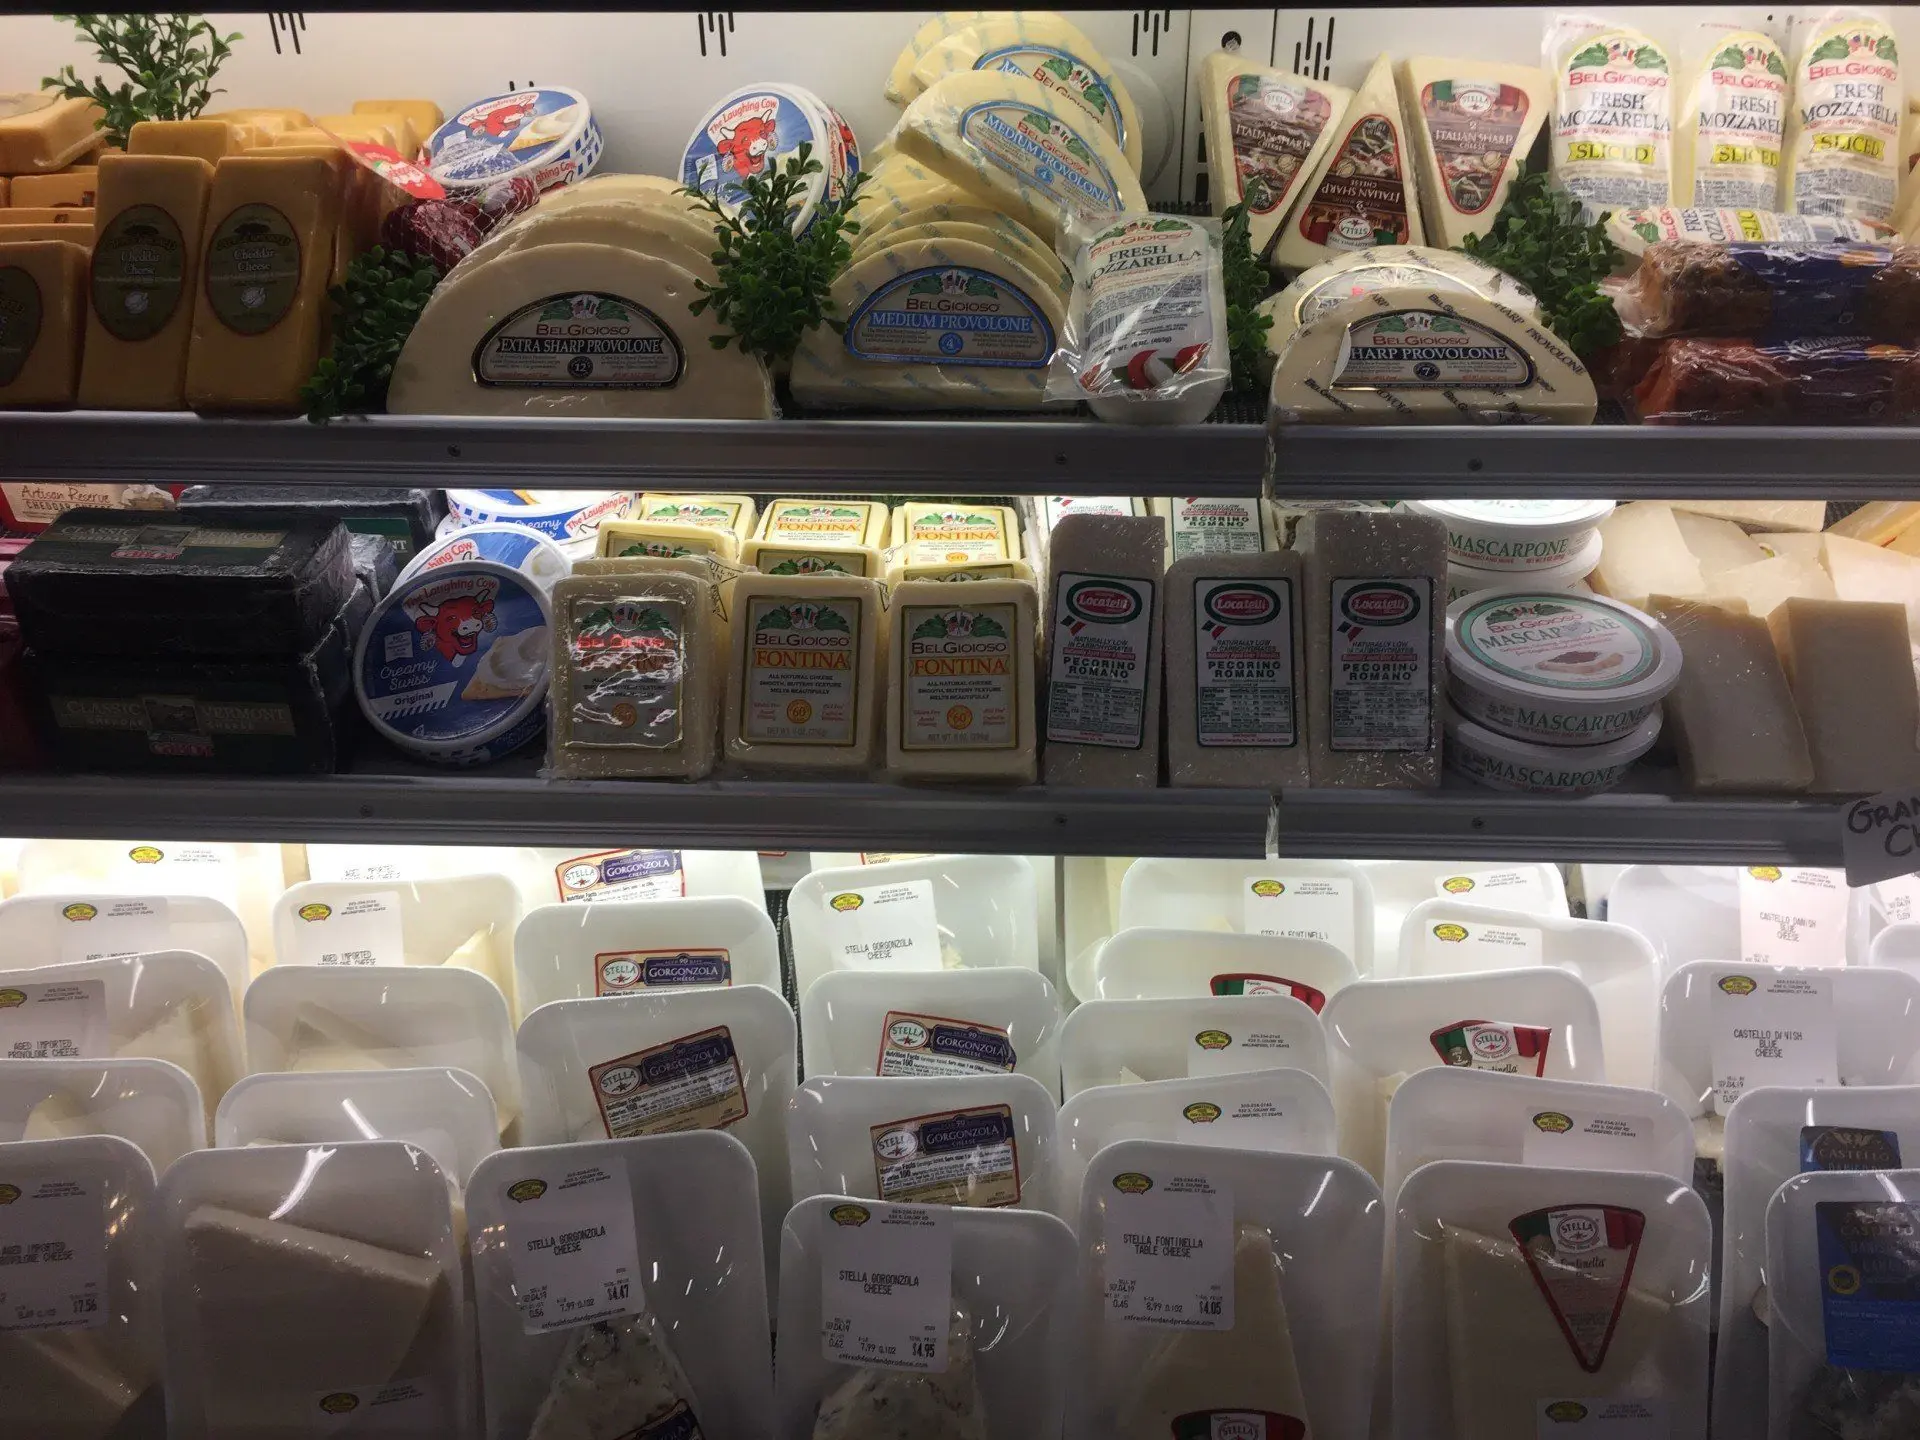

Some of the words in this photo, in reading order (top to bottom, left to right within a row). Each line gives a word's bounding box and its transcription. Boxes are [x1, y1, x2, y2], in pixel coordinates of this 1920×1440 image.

[1835, 84, 1884, 100] FRESH
[1592, 92, 1647, 109] FRESH
[1731, 95, 1778, 115] FRESH
[709, 121, 724, 135] The
[722, 101, 761, 123] Laughing
[760, 98, 778, 110] Cow
[1559, 110, 1670, 131] MOZZARELLA
[1801, 102, 1897, 127] MOZZARELLA
[1237, 124, 1274, 141] ITALIAN
[1274, 136, 1311, 149] SHARP
[1436, 130, 1478, 141] ITALIAN
[1480, 134, 1515, 144] SHARP
[1821, 135, 1881, 156] SLICED
[985, 112, 1040, 157] MEDIUM
[1038, 151, 1110, 207] PROVOLONE
[1322, 183, 1357, 196] SHARP
[1360, 189, 1401, 203] ITALIAN
[233, 248, 274, 261] Cheddar
[1110, 246, 1169, 264] FRESH
[237, 261, 271, 271] Cheese
[872, 312, 936, 328] MEDIUM
[940, 314, 1032, 331] PROVOLONE
[500, 340, 541, 353] EXTRA
[545, 340, 585, 353] SHARP
[588, 340, 661, 353] PROVOLONE
[1525, 327, 1583, 376] PROVOLONE
[1403, 348, 1506, 360] PROVOLONE
[22, 485, 64, 500] Artisan
[68, 488, 111, 503] Reserve
[568, 518, 583, 530] The
[583, 498, 618, 518] Laughing
[916, 532, 996, 540] FONTINA
[451, 543, 473, 555] Cow
[1449, 532, 1568, 558] MASCARPONE
[424, 580, 474, 596] Laughing
[474, 577, 498, 589] Cow
[1079, 593, 1129, 608] Locatelli
[1217, 600, 1268, 610] Locatelli
[1355, 599, 1405, 609] Locatelli
[757, 651, 846, 668] FONTINA
[915, 659, 1005, 674] FONTINA
[1064, 657, 1135, 671] PECORINO
[1208, 661, 1281, 669] PECORINO
[381, 660, 440, 679] Creamy
[1069, 666, 1128, 678] ROMANO
[1215, 670, 1275, 678] ROMANO
[1343, 663, 1418, 672] PECORINO
[390, 675, 431, 690] Swiss
[1350, 673, 1411, 681] ROMANO
[395, 692, 433, 705] Original
[66, 701, 140, 714] CLASSIC
[203, 705, 284, 720] VERMONT
[1518, 707, 1644, 732] MASCARPONE
[1485, 757, 1617, 787] MASCARPONE
[566, 868, 596, 881] STELLA
[607, 859, 670, 877] GORGONZOLA
[1760, 912, 1790, 923] CASTELLO
[1777, 931, 1800, 942] CHEESE
[845, 944, 869, 954] STELLA
[872, 937, 913, 950] GORGONZOLA
[321, 954, 336, 962] AGED
[340, 950, 372, 959] IMPORTED
[868, 951, 892, 960] CHEESE
[606, 966, 636, 976] STELLA
[650, 967, 718, 977] GORGONZOLA
[1477, 1034, 1504, 1044] STELLA
[1733, 1028, 1771, 1039] CASTELLO
[14, 1041, 32, 1050] AGED
[37, 1039, 72, 1049] IMPORTED
[893, 1026, 924, 1038] STELLA
[937, 1035, 1005, 1056] GORGONZOLA
[1760, 1039, 1778, 1049] BLUE
[8, 1049, 48, 1058] PROVOLONE
[52, 1047, 79, 1057] CHEESE
[959, 1049, 981, 1057] CHEESE
[1755, 1048, 1783, 1058] CHEESE
[604, 1071, 636, 1087] STELLA
[650, 1047, 721, 1076] GORGONZOLA
[903, 1058, 914, 1066] 100
[927, 1124, 999, 1144] GORGONZOLA
[1561, 1221, 1593, 1233] STELLA
[527, 1237, 556, 1251] STELLA
[559, 1226, 606, 1244] GORGONZOLA
[1123, 1233, 1152, 1245] STELLA
[1155, 1236, 1204, 1249] FONTINELLA
[553, 1241, 582, 1255] CHEESE
[1135, 1245, 1158, 1256] TABLE
[1162, 1246, 1191, 1258] CHEESE
[43, 1250, 74, 1262] CHEESE
[839, 1270, 868, 1283] STELLA
[871, 1273, 919, 1287] GORGONZOLA
[607, 1284, 629, 1300] $4.47
[863, 1284, 892, 1295] CHEESE
[74, 1298, 98, 1313] $7.56
[1146, 1302, 1162, 1311] 8.99
[1199, 1300, 1222, 1315] $4.05
[860, 1342, 876, 1353] 7.99
[912, 1342, 935, 1358] $4.95
